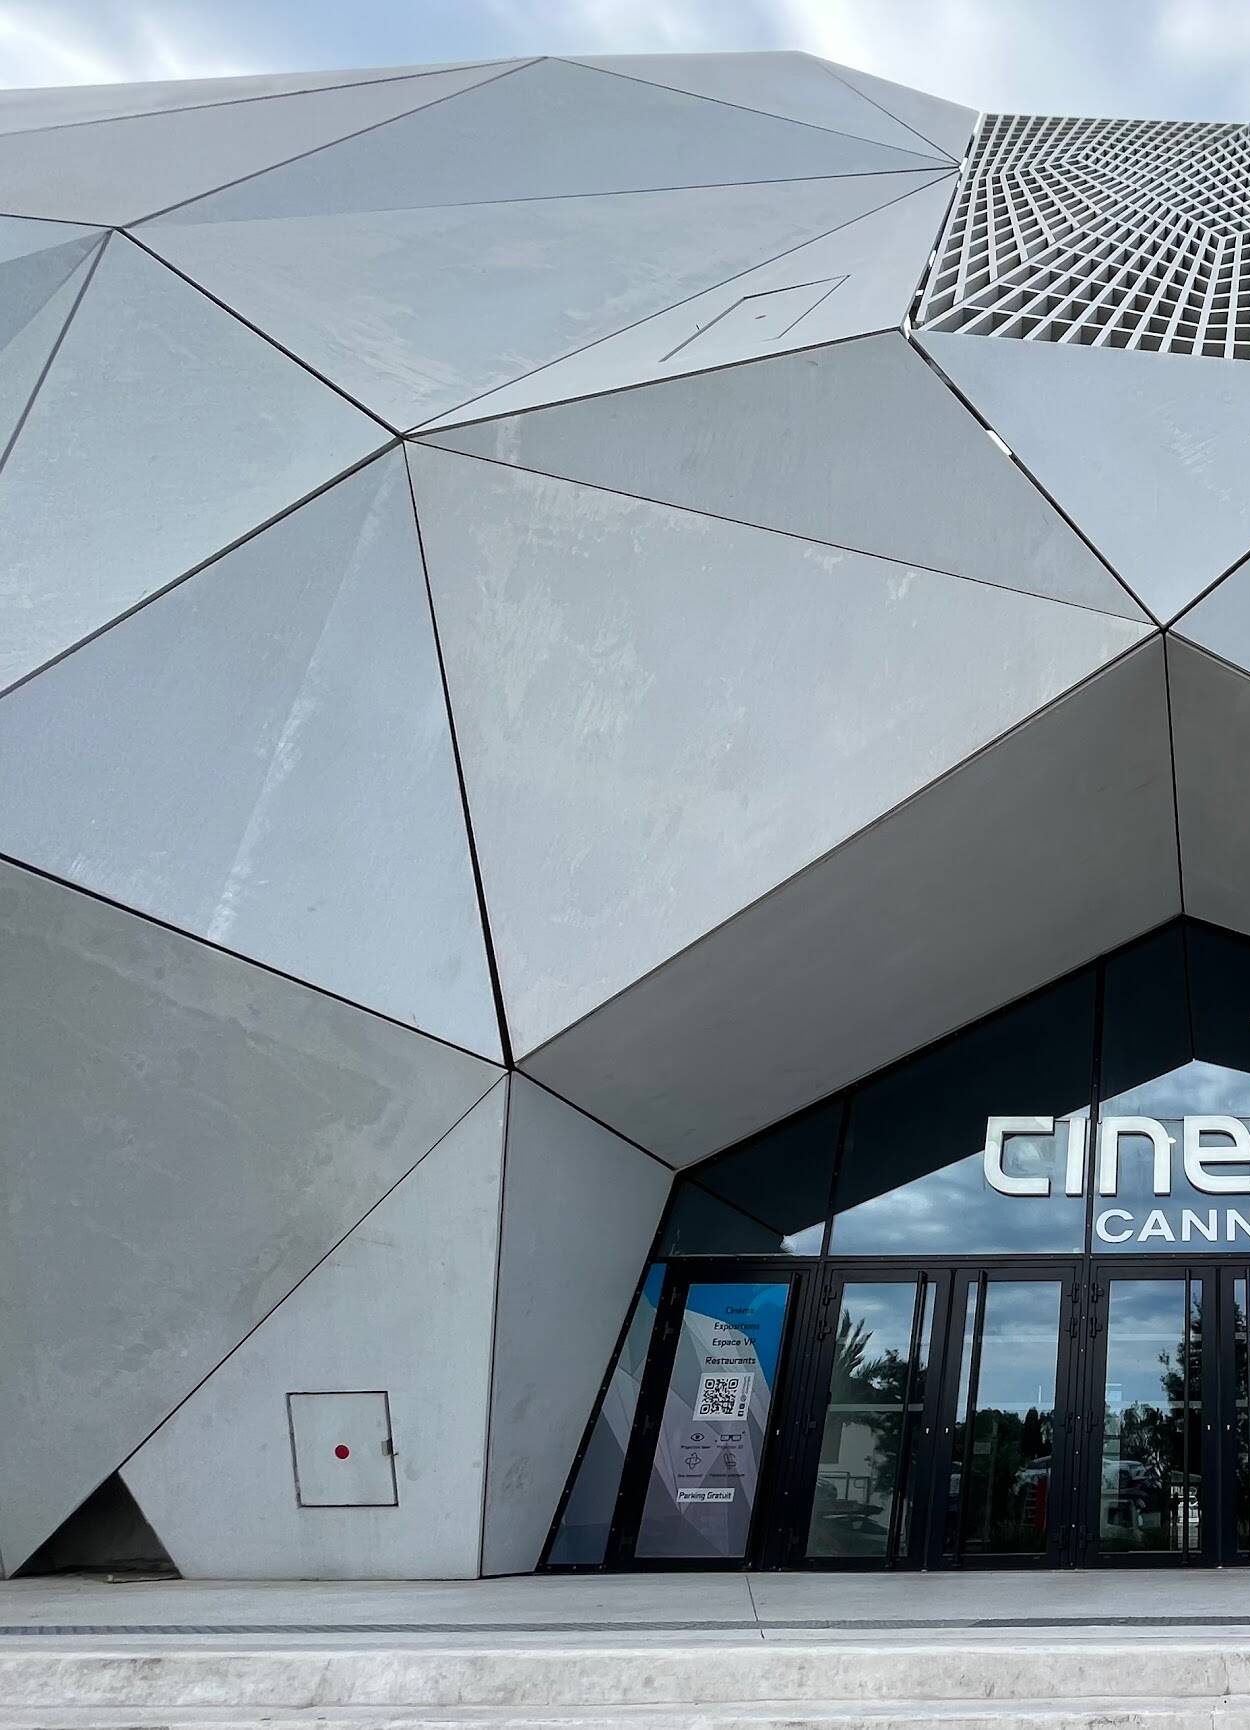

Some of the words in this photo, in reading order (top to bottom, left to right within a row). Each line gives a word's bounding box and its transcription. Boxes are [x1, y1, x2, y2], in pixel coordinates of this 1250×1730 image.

[714, 1322, 760, 1331] Expositions
[712, 1338, 741, 1348] Espace
[744, 1338, 757, 1346] VR
[705, 1356, 756, 1365] Restaurants
[679, 1492, 705, 1501] Parking
[707, 1491, 731, 1500] Gratuit
